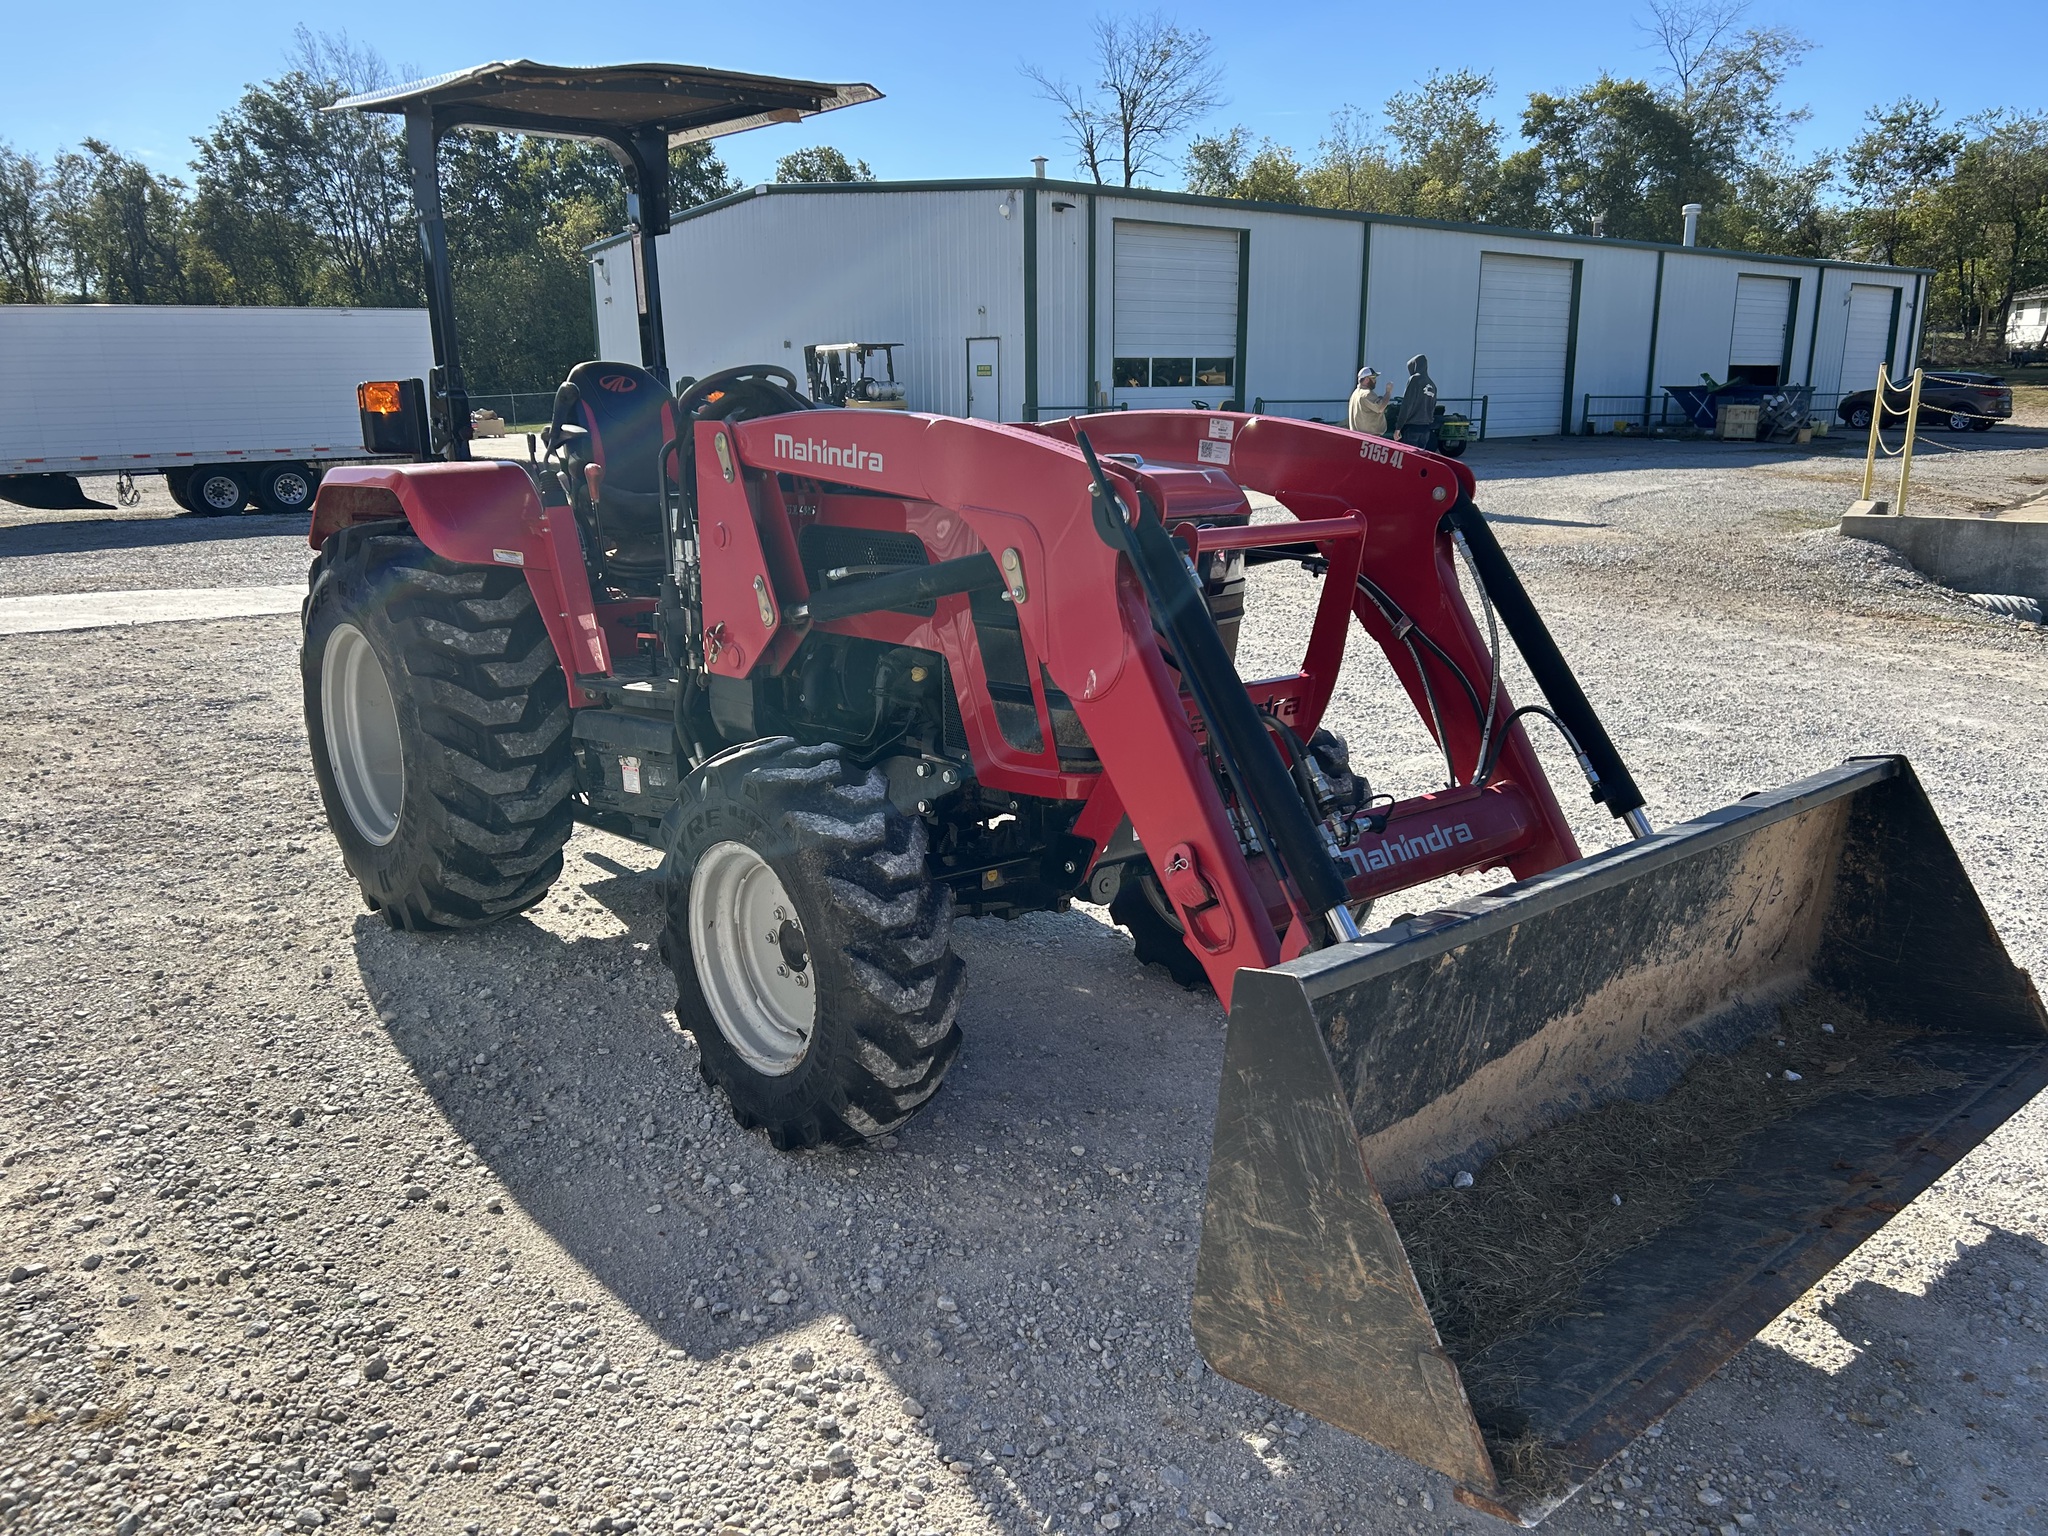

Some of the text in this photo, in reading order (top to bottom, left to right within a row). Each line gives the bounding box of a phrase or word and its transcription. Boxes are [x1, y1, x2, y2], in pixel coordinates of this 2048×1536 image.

[774, 433, 883, 473] Mahindra
[1360, 440, 1404, 470] 5155 4L
[1340, 822, 1474, 876] Mahindra
